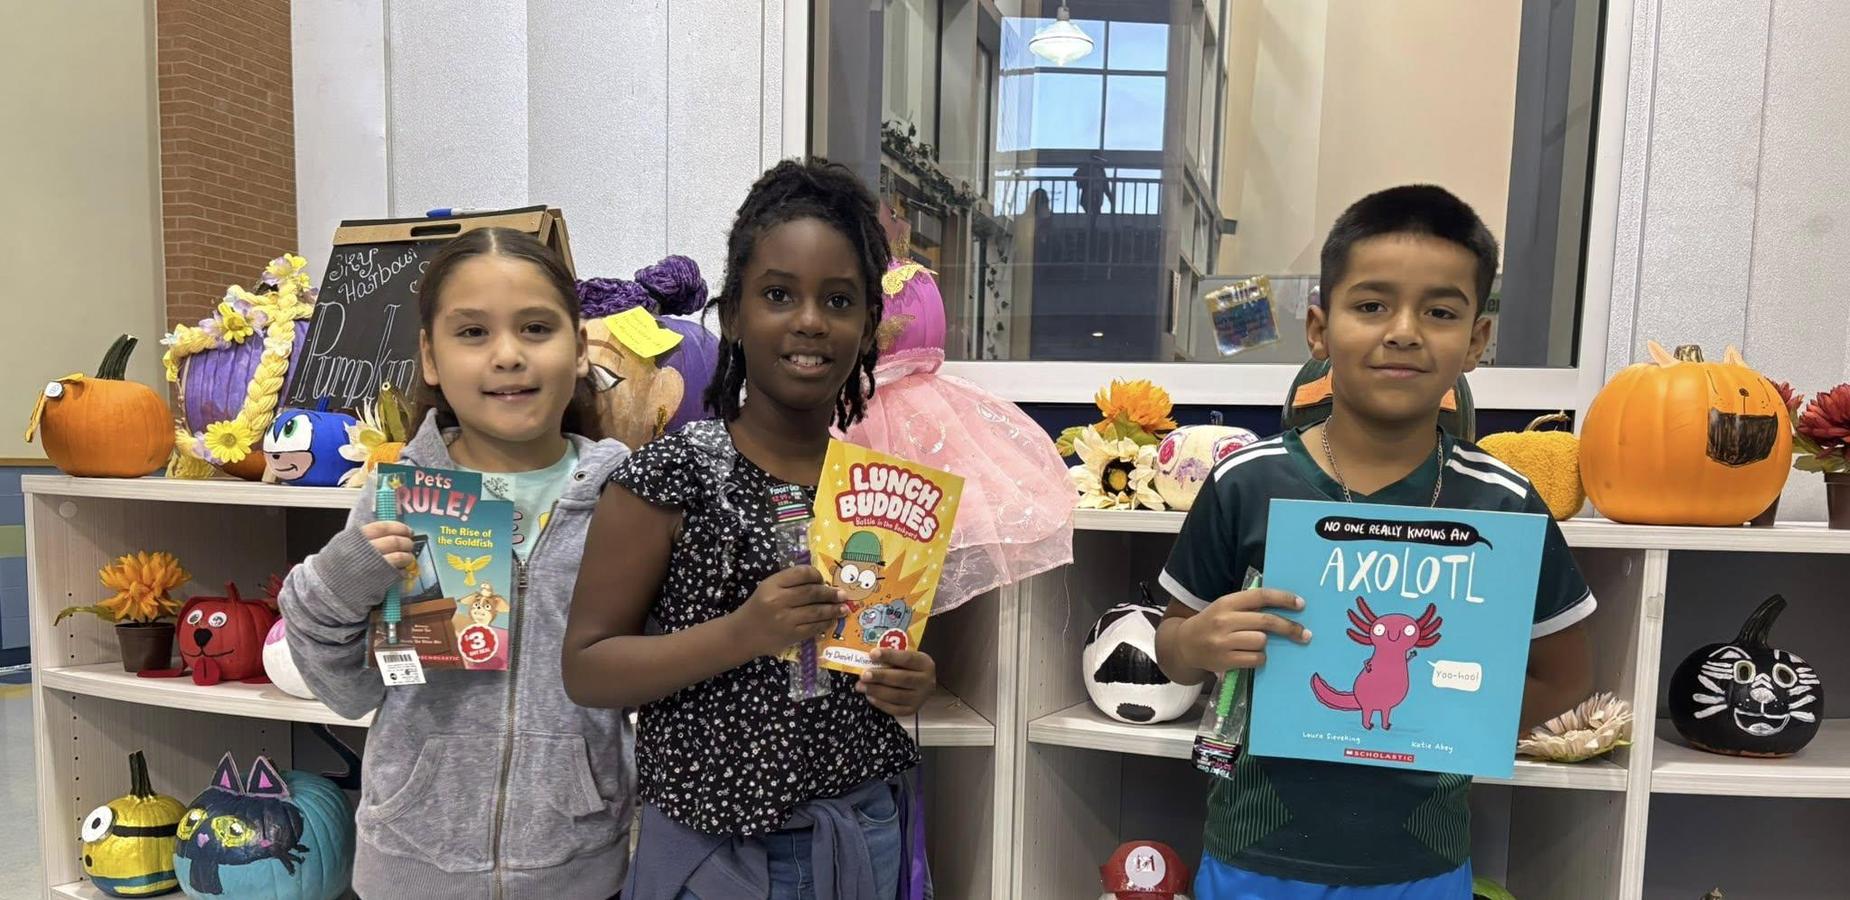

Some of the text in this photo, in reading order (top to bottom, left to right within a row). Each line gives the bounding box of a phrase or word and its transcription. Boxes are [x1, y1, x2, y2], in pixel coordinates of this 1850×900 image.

[415, 470, 452, 489] Pets
[853, 466, 940, 511] LUNCH
[396, 486, 478, 521] RULE!
[840, 491, 937, 539] BUDDIES
[855, 517, 875, 526] Battle
[440, 525, 492, 537] The Rise of
[1324, 521, 1470, 541] NO ONE REALLY KNOWS AN
[438, 536, 493, 548] the Goldfish
[1320, 547, 1485, 604] AXOLOTL
[825, 650, 833, 659] by
[1436, 670, 1480, 682] Yoo-hoo!
[1303, 732, 1323, 740] Laura
[1411, 741, 1431, 749] Katie
[1354, 751, 1413, 762] SCHOLASTIC
